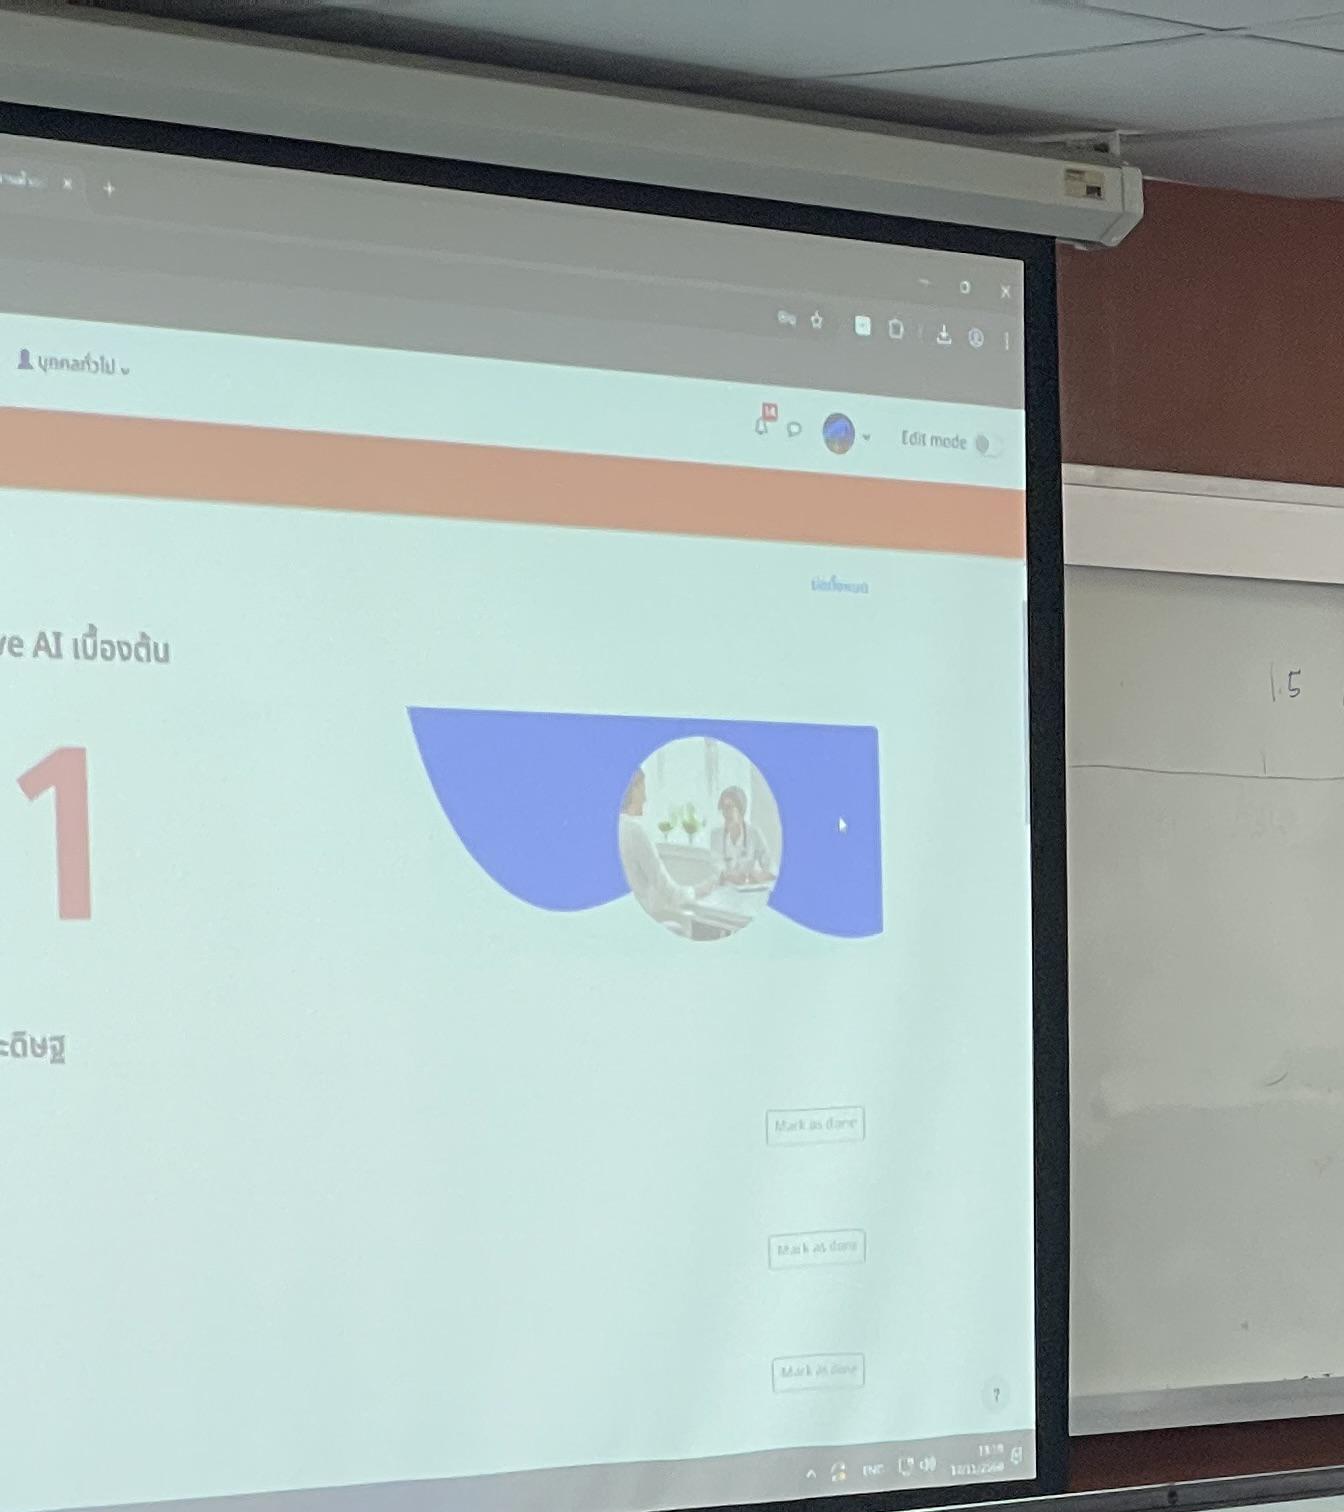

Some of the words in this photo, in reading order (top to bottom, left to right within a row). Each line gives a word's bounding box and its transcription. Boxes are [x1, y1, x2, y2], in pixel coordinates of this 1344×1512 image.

[901, 430, 925, 447] Edit
[930, 434, 967, 450] mode
[32, 631, 63, 659] AI
[72, 623, 170, 663] เบื้องต้น
[16, 747, 92, 920] 1
